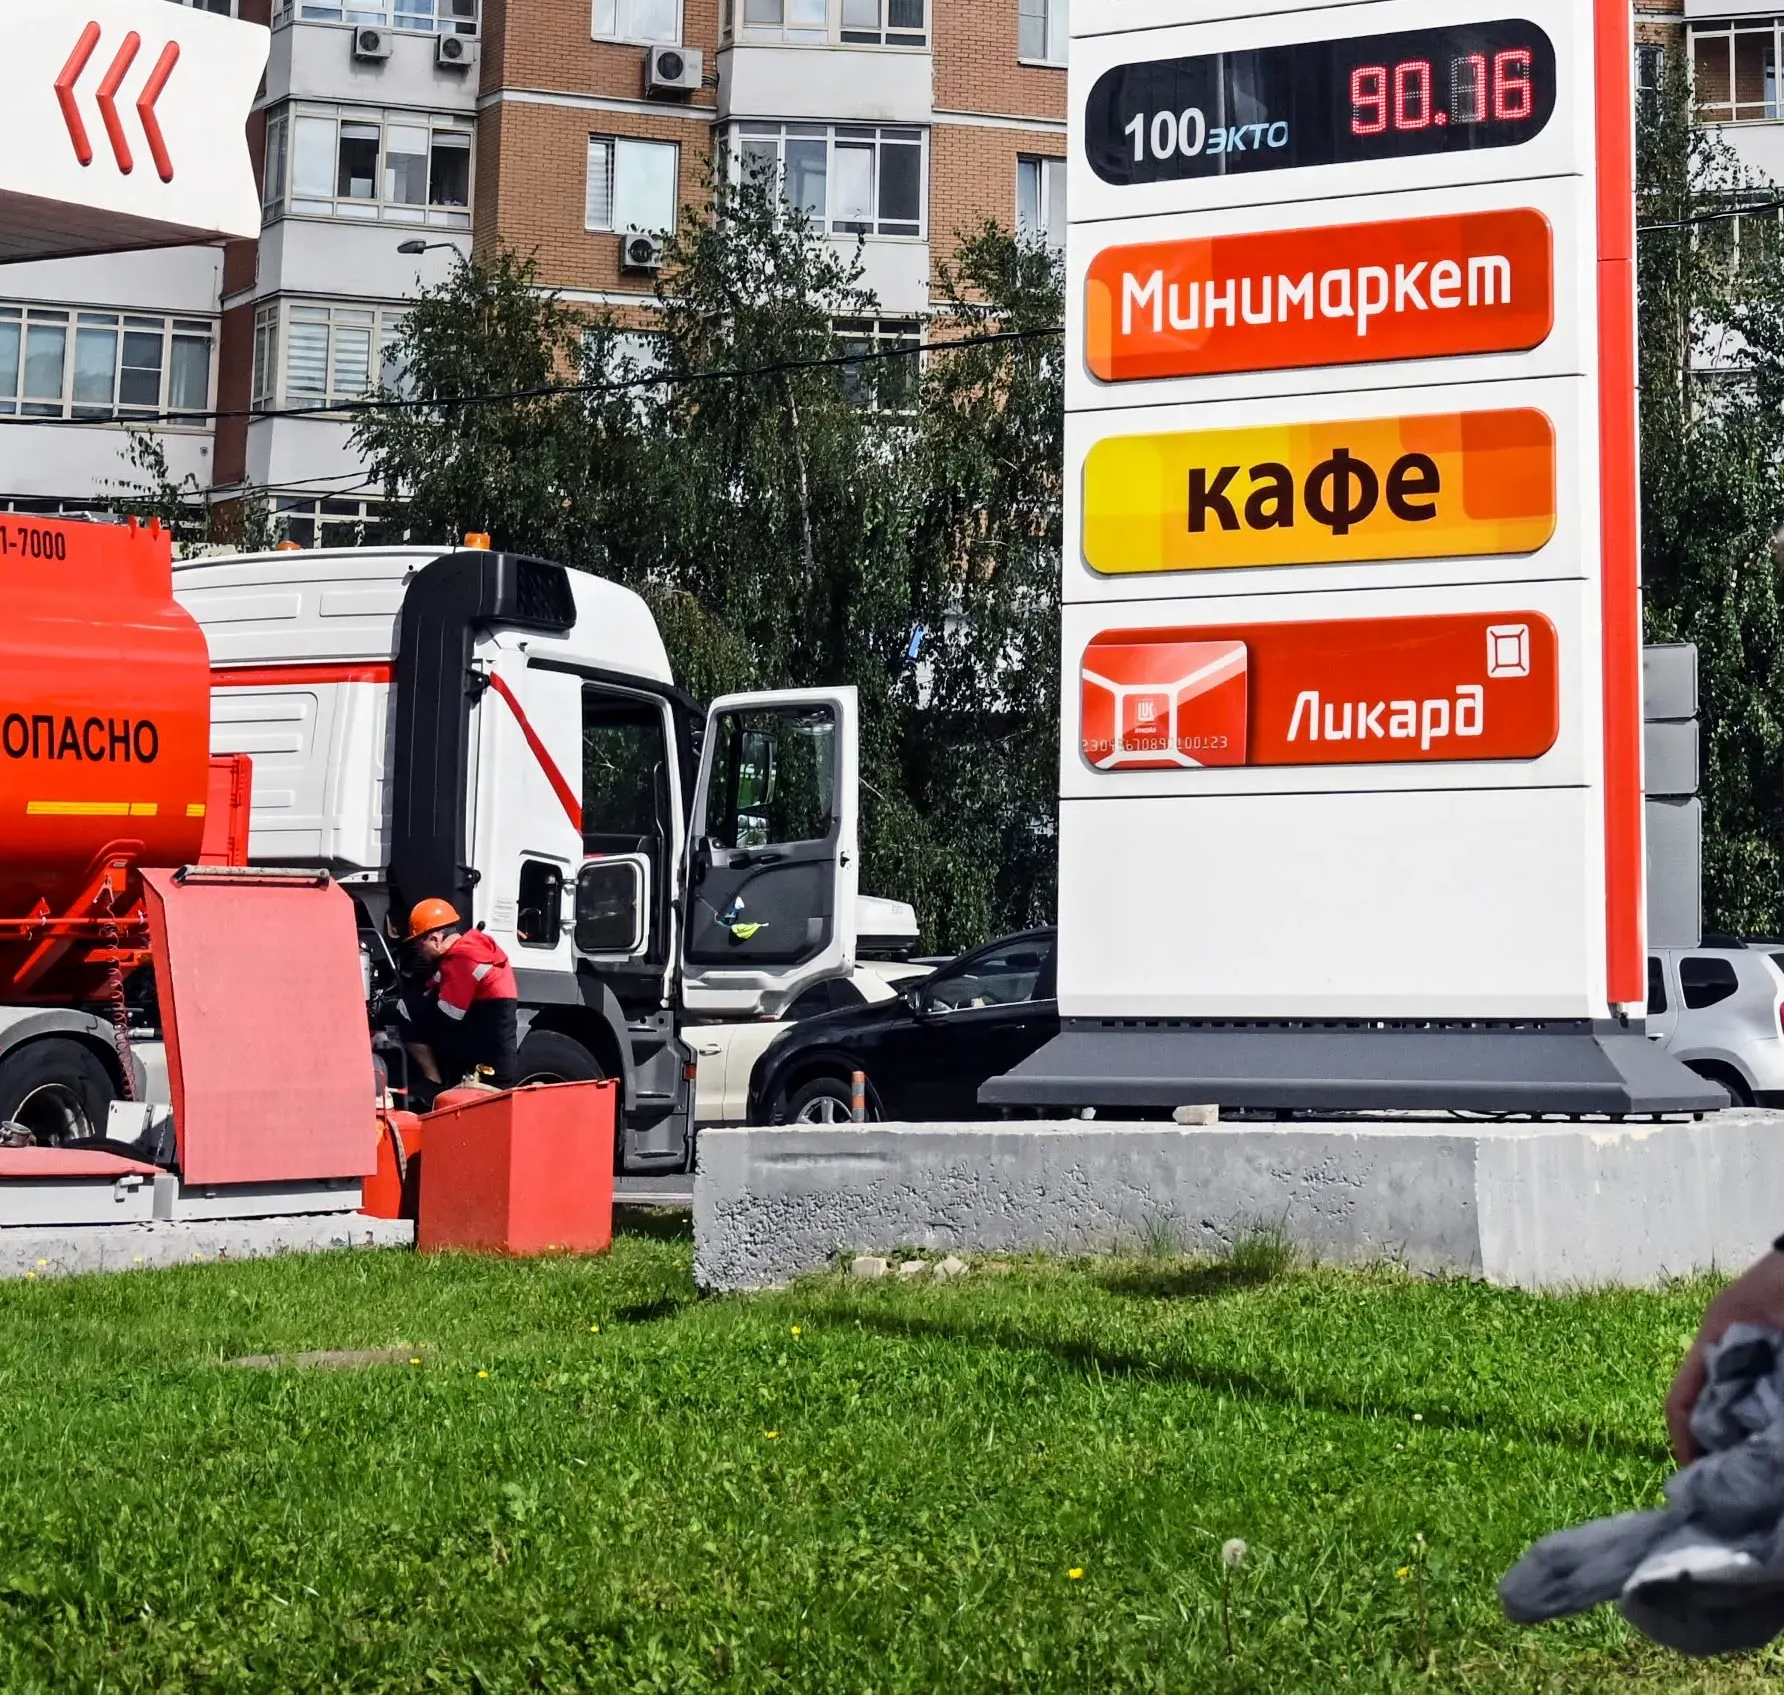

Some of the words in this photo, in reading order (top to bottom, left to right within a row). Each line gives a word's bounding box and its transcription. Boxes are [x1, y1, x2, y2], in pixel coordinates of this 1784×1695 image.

[1125, 108, 1205, 161] 100
[1206, 120, 1289, 155] ЭКТО
[1351, 49, 1532, 134] 90.16
[1121, 254, 1511, 336] Минимаркет
[1187, 448, 1440, 535] кафе
[1287, 684, 1483, 750] Ликард
